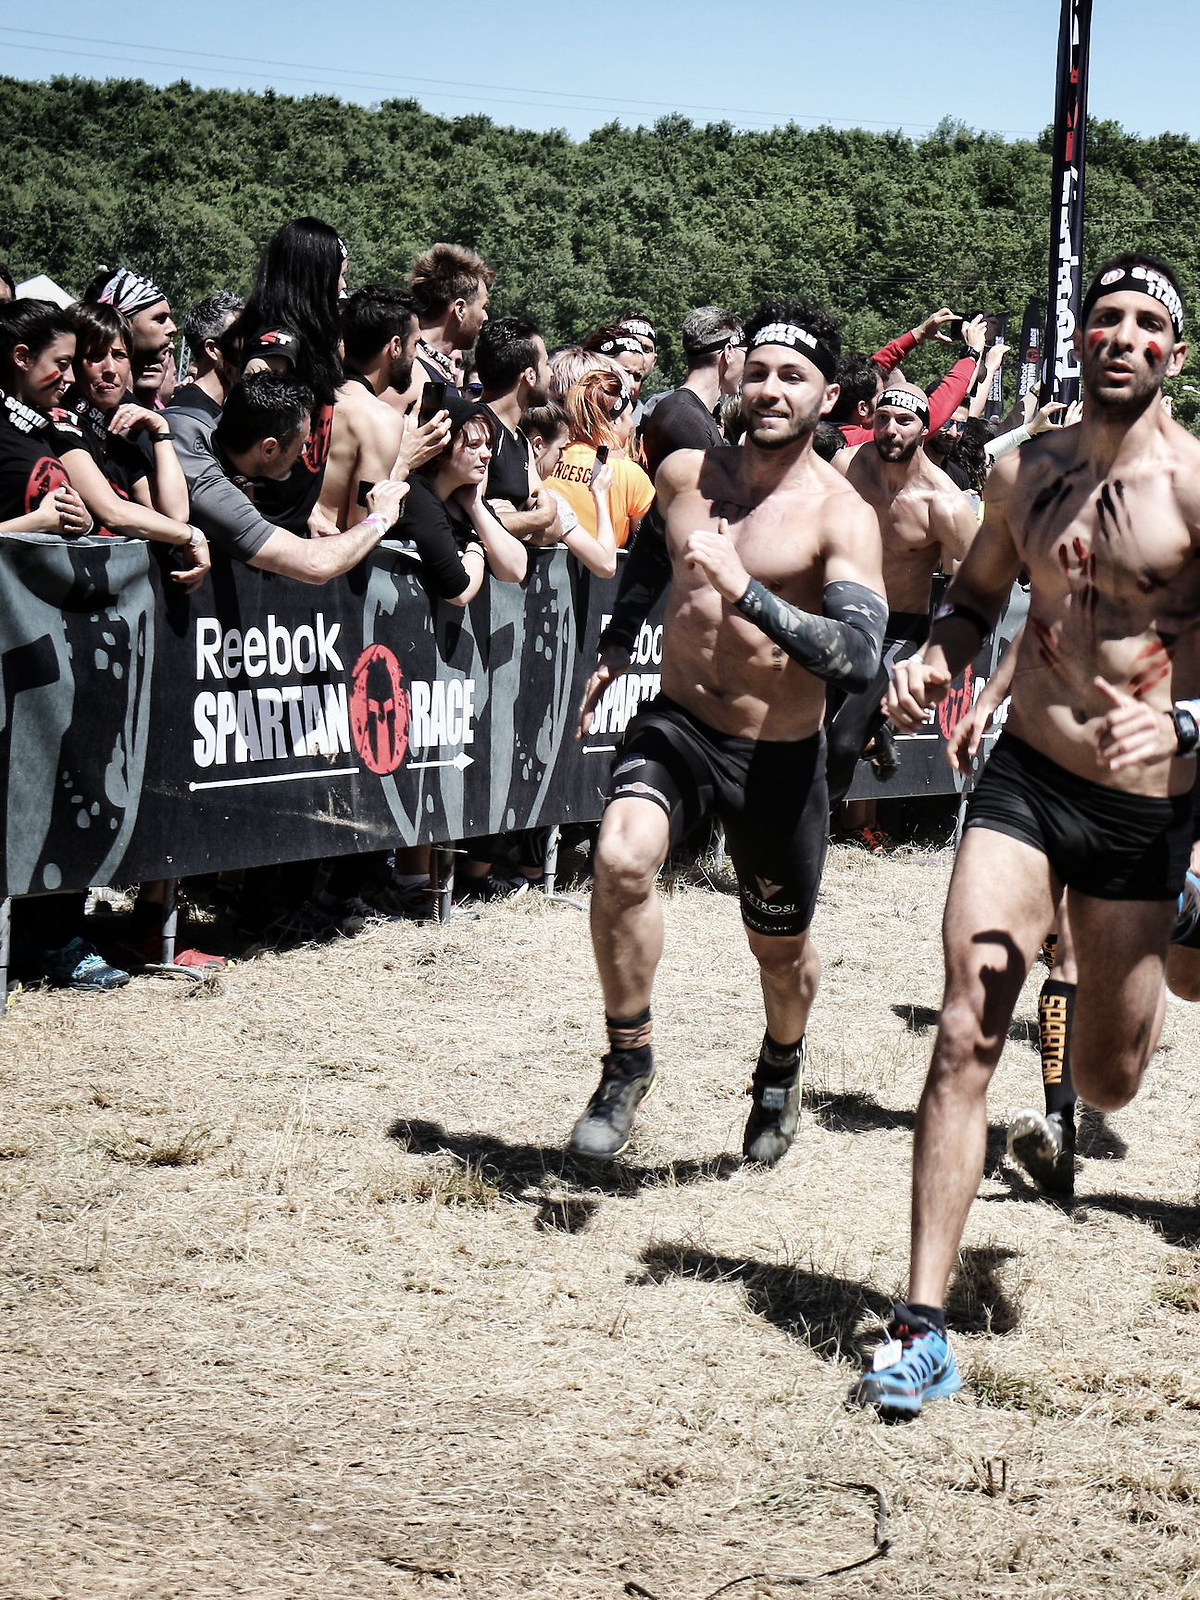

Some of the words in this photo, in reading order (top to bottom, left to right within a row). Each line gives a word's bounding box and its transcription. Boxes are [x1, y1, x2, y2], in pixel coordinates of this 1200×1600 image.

[550, 461, 592, 484] NCESC
[195, 613, 345, 680] Reebok
[193, 682, 351, 768] SPARTAN
[410, 678, 476, 748] RACE
[1041, 995, 1067, 1084] SPARTAN
